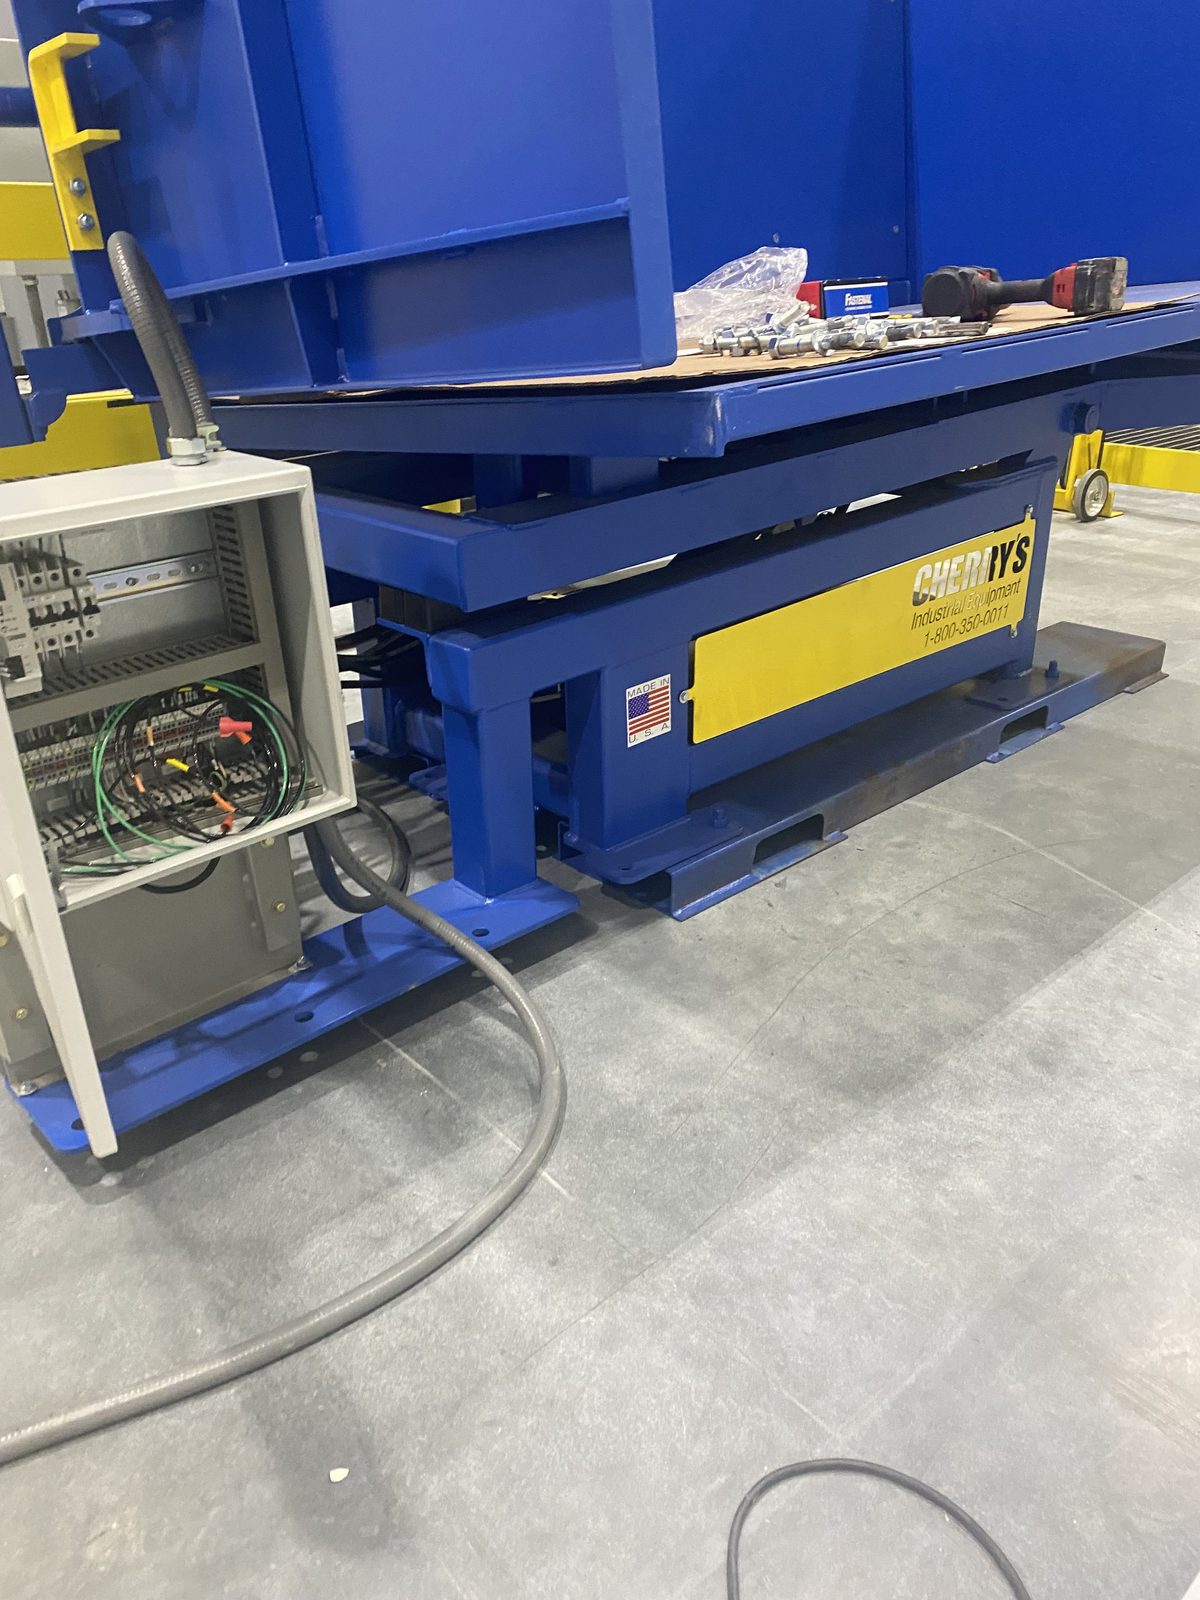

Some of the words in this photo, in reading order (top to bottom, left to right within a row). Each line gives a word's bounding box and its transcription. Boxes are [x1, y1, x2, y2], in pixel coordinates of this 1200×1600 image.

[912, 534, 1030, 606] CHERRY'S
[911, 601, 966, 630] Industrial
[966, 579, 1021, 612] Equipment
[923, 603, 1009, 648] 1-800-350-0011
[627, 681, 656, 698] MADE
[660, 677, 670, 686] IN
